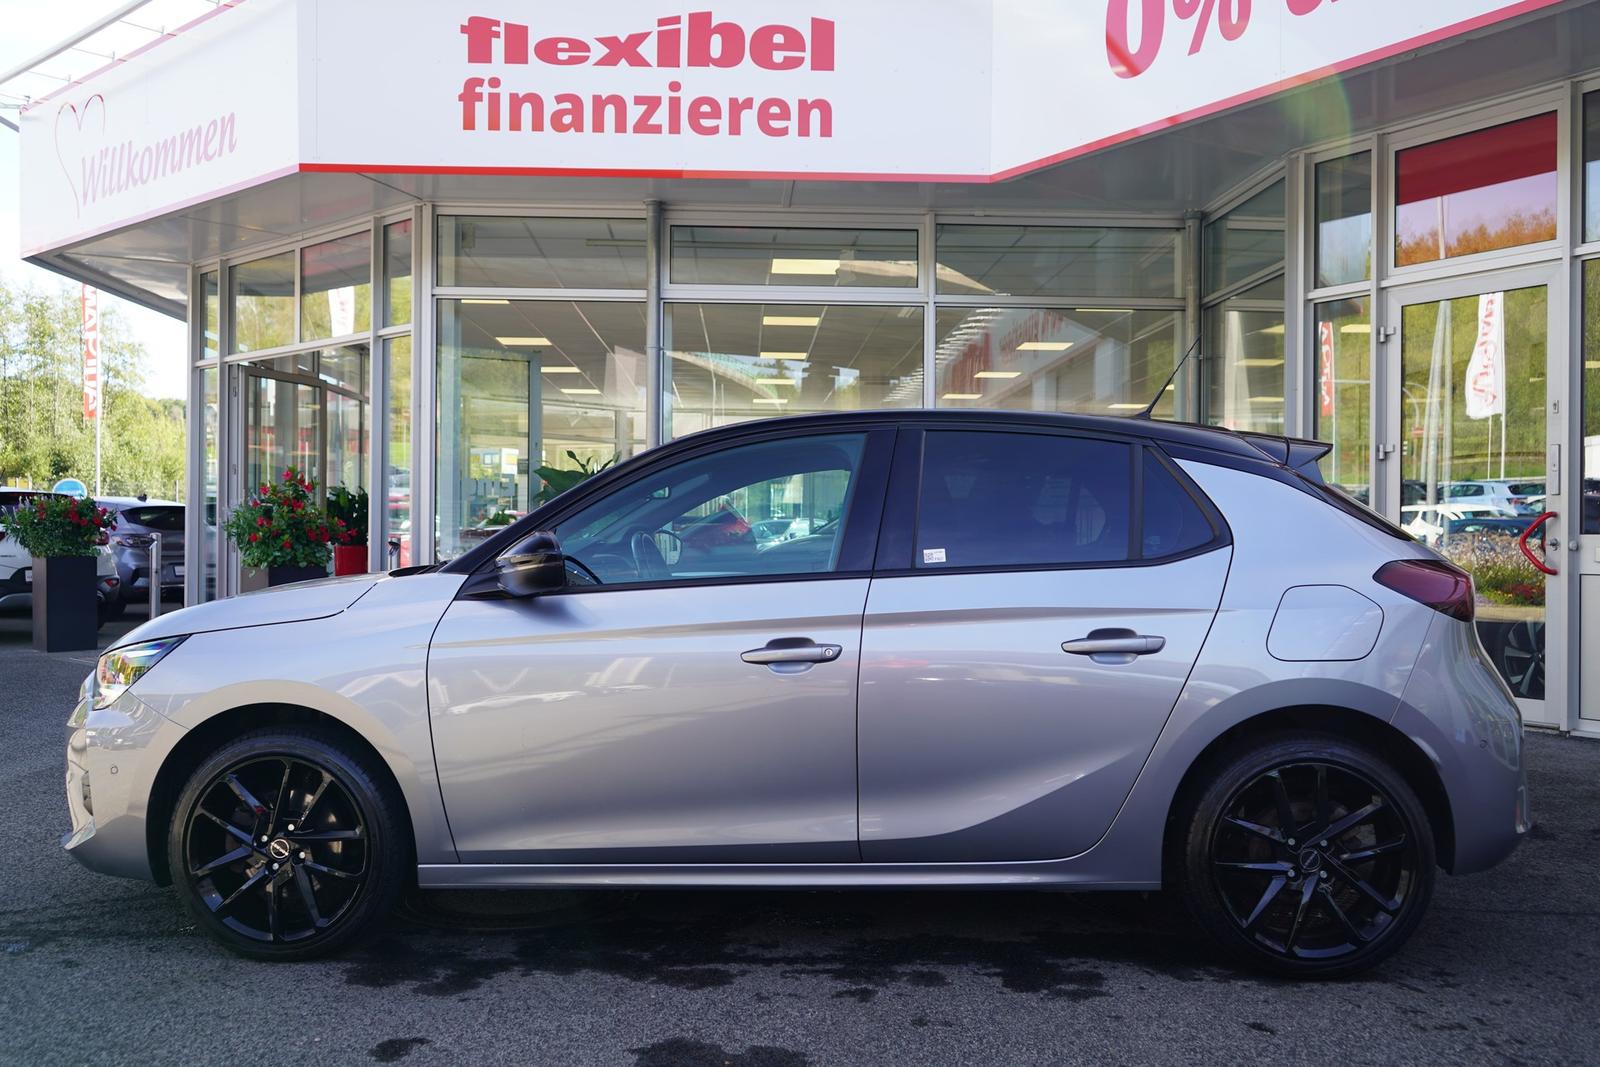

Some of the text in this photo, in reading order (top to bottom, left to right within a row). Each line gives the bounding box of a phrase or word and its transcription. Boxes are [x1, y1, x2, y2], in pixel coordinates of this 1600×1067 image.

[459, 10, 836, 71] flexibel
[458, 75, 834, 138] finanzieren
[81, 111, 238, 206] Willkommen
